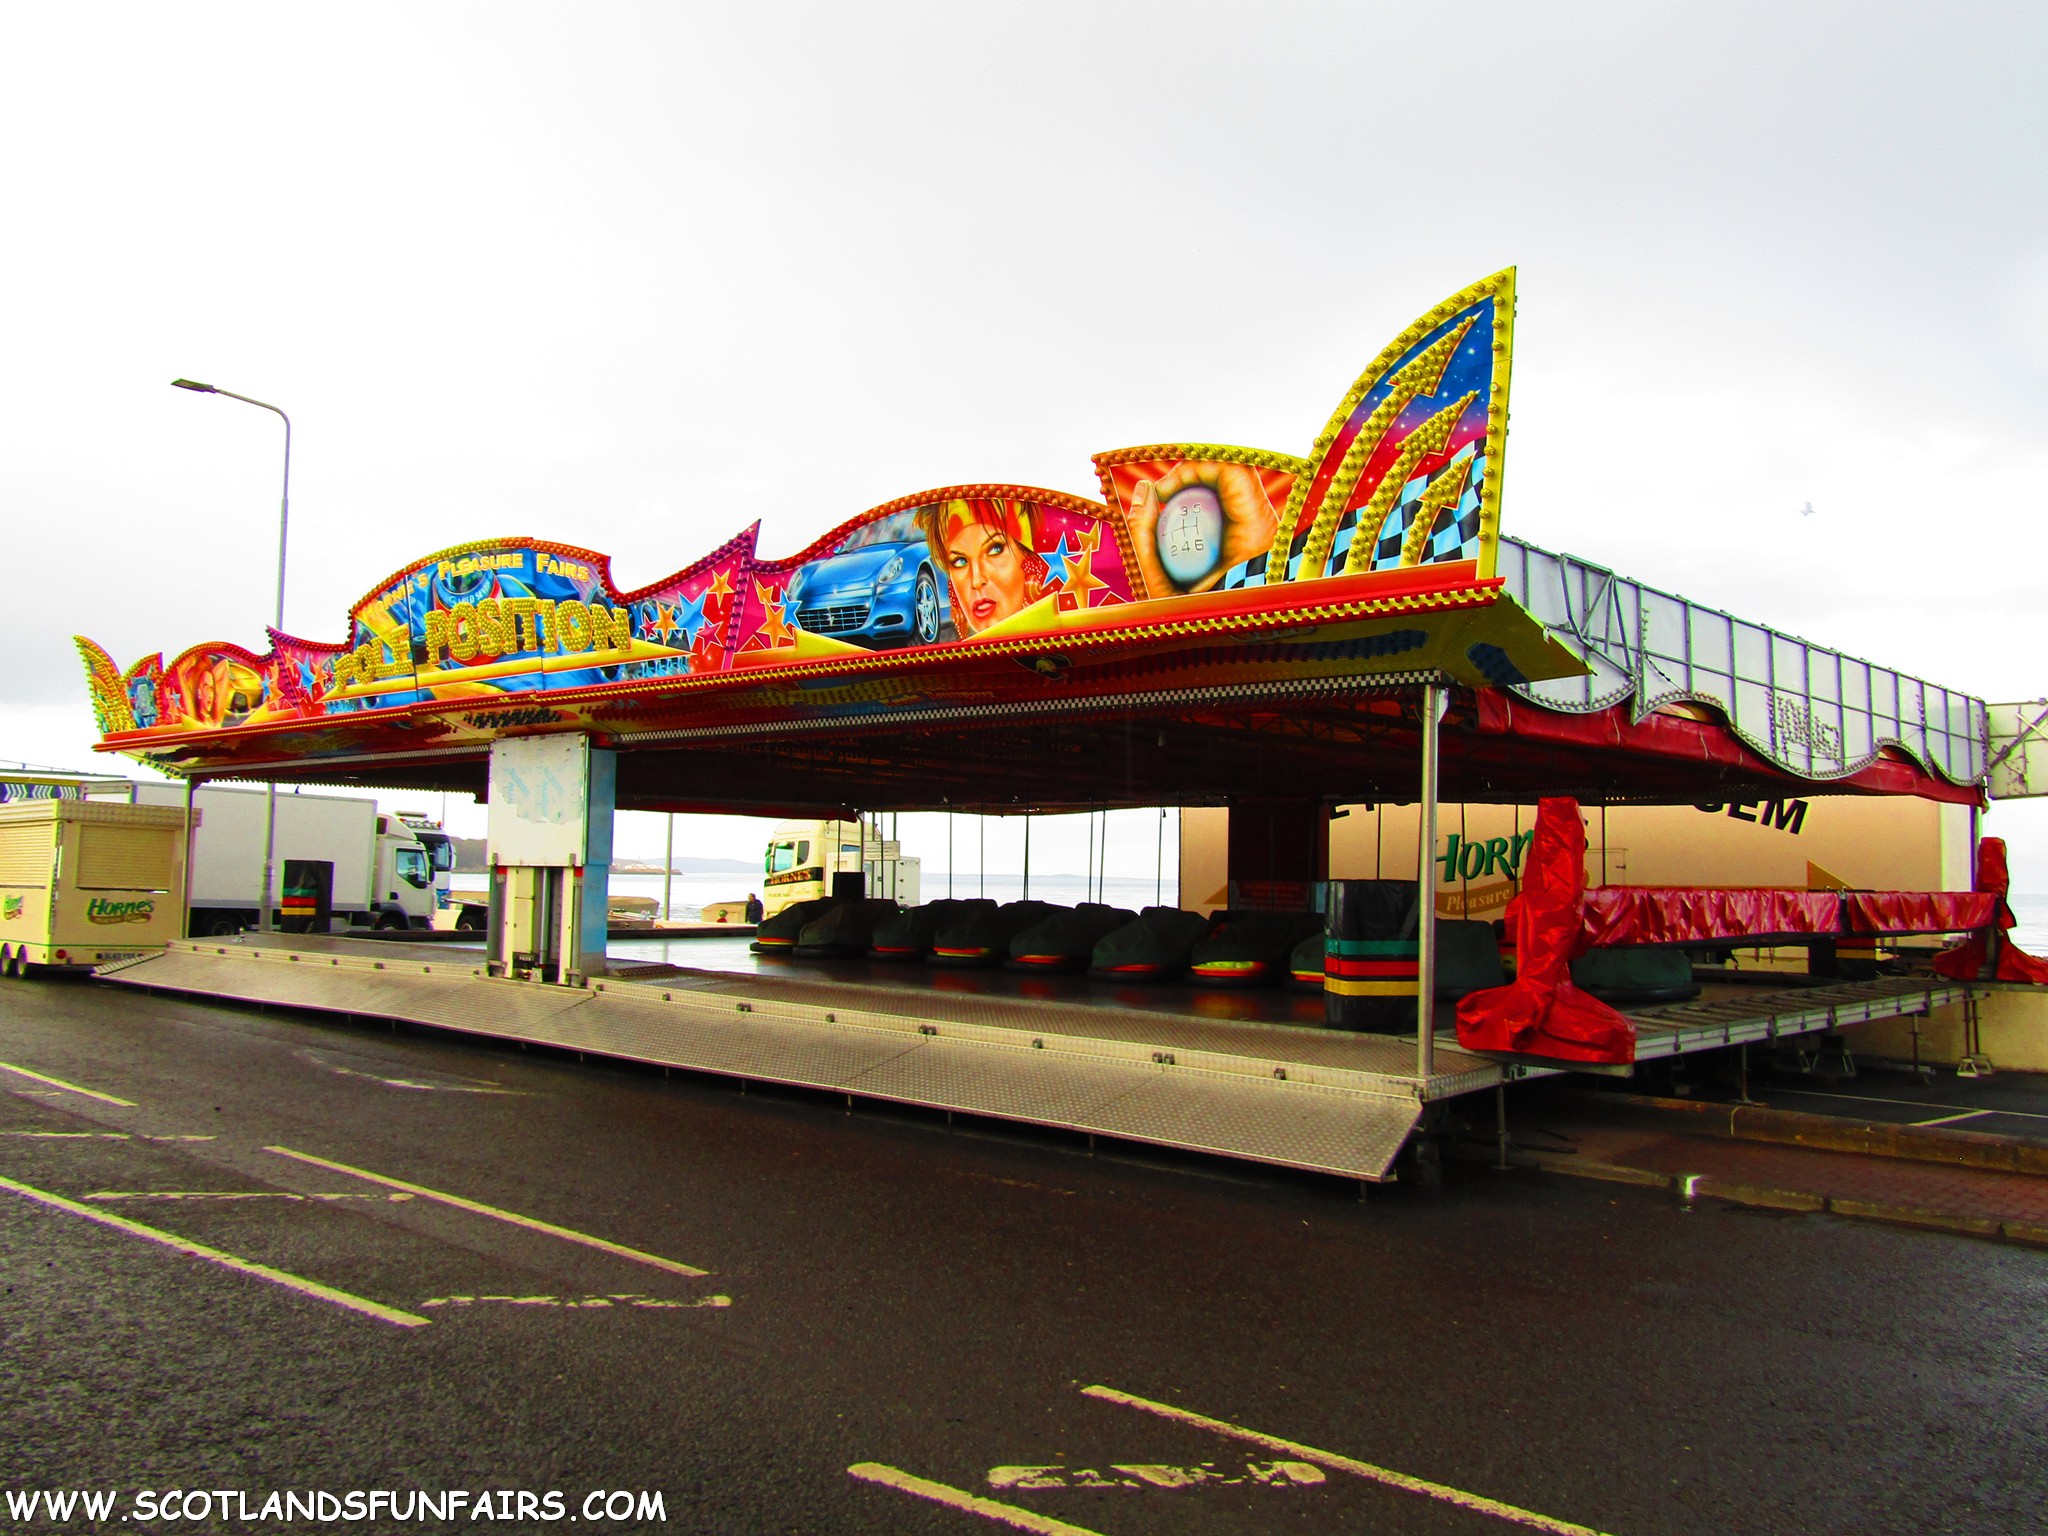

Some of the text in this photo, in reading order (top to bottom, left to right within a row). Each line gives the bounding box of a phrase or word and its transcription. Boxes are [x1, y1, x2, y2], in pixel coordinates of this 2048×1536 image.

[1181, 506, 1188, 516] 3
[1181, 541, 1190, 552] 4
[437, 553, 524, 580] PLEASURE
[536, 553, 590, 582] FAIRS
[335, 597, 633, 691] POLE POSITION
[1446, 886, 1511, 912] Pleasure
